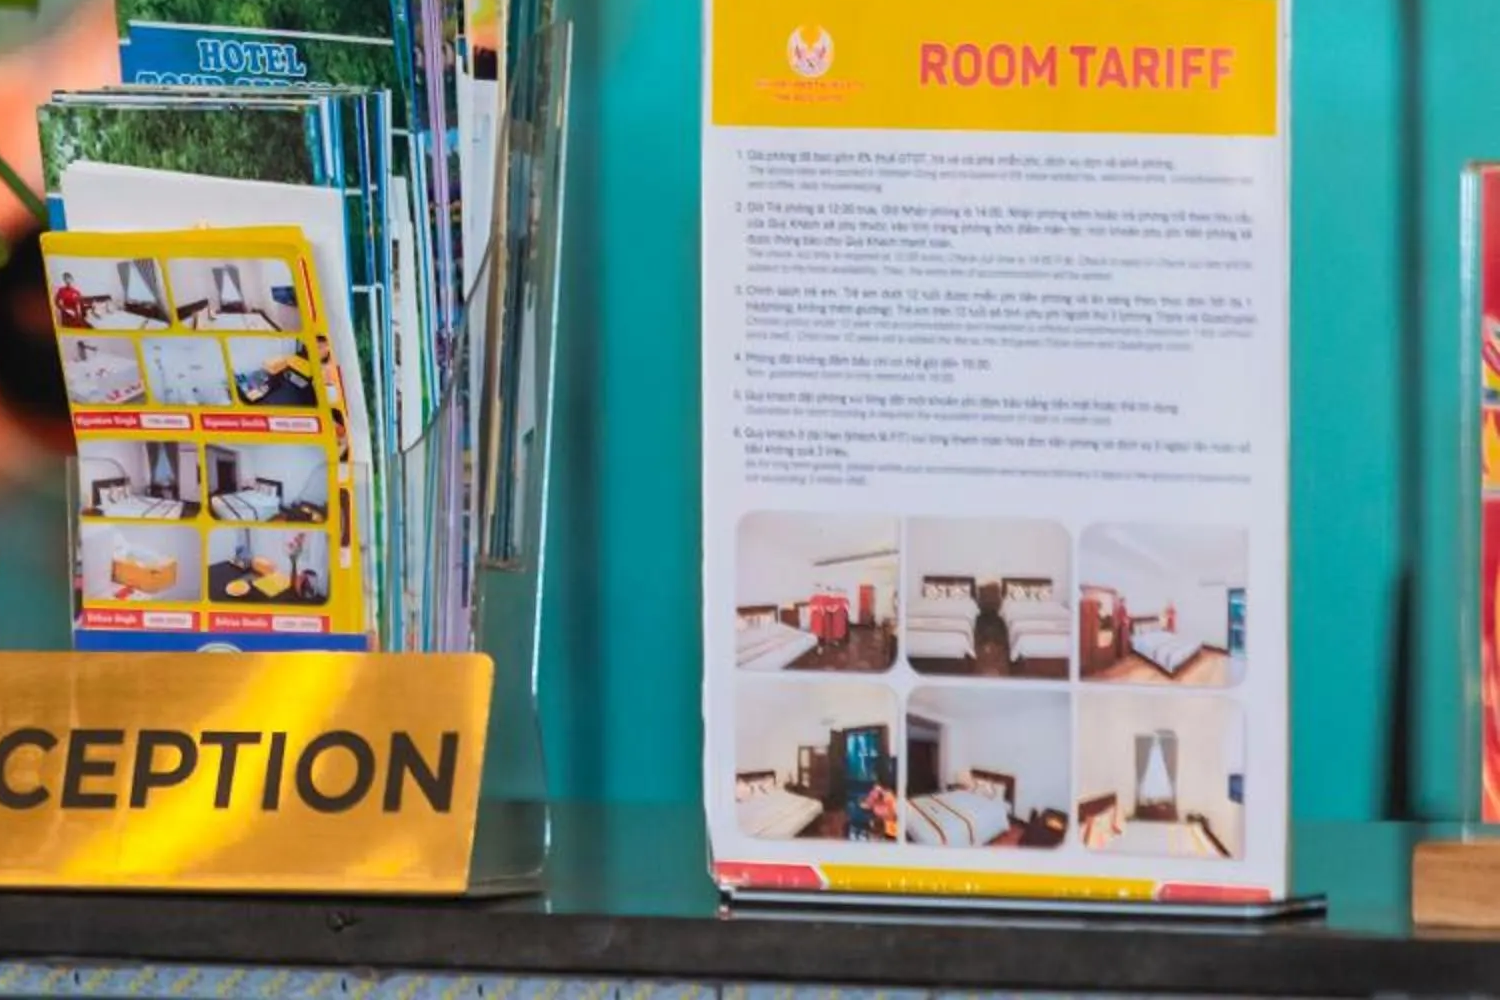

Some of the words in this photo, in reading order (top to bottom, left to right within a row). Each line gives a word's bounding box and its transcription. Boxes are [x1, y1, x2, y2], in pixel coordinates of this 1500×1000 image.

[197, 38, 306, 76] HOTEL
[919, 42, 1057, 87] ROOM
[1069, 45, 1235, 90] TARIFF
